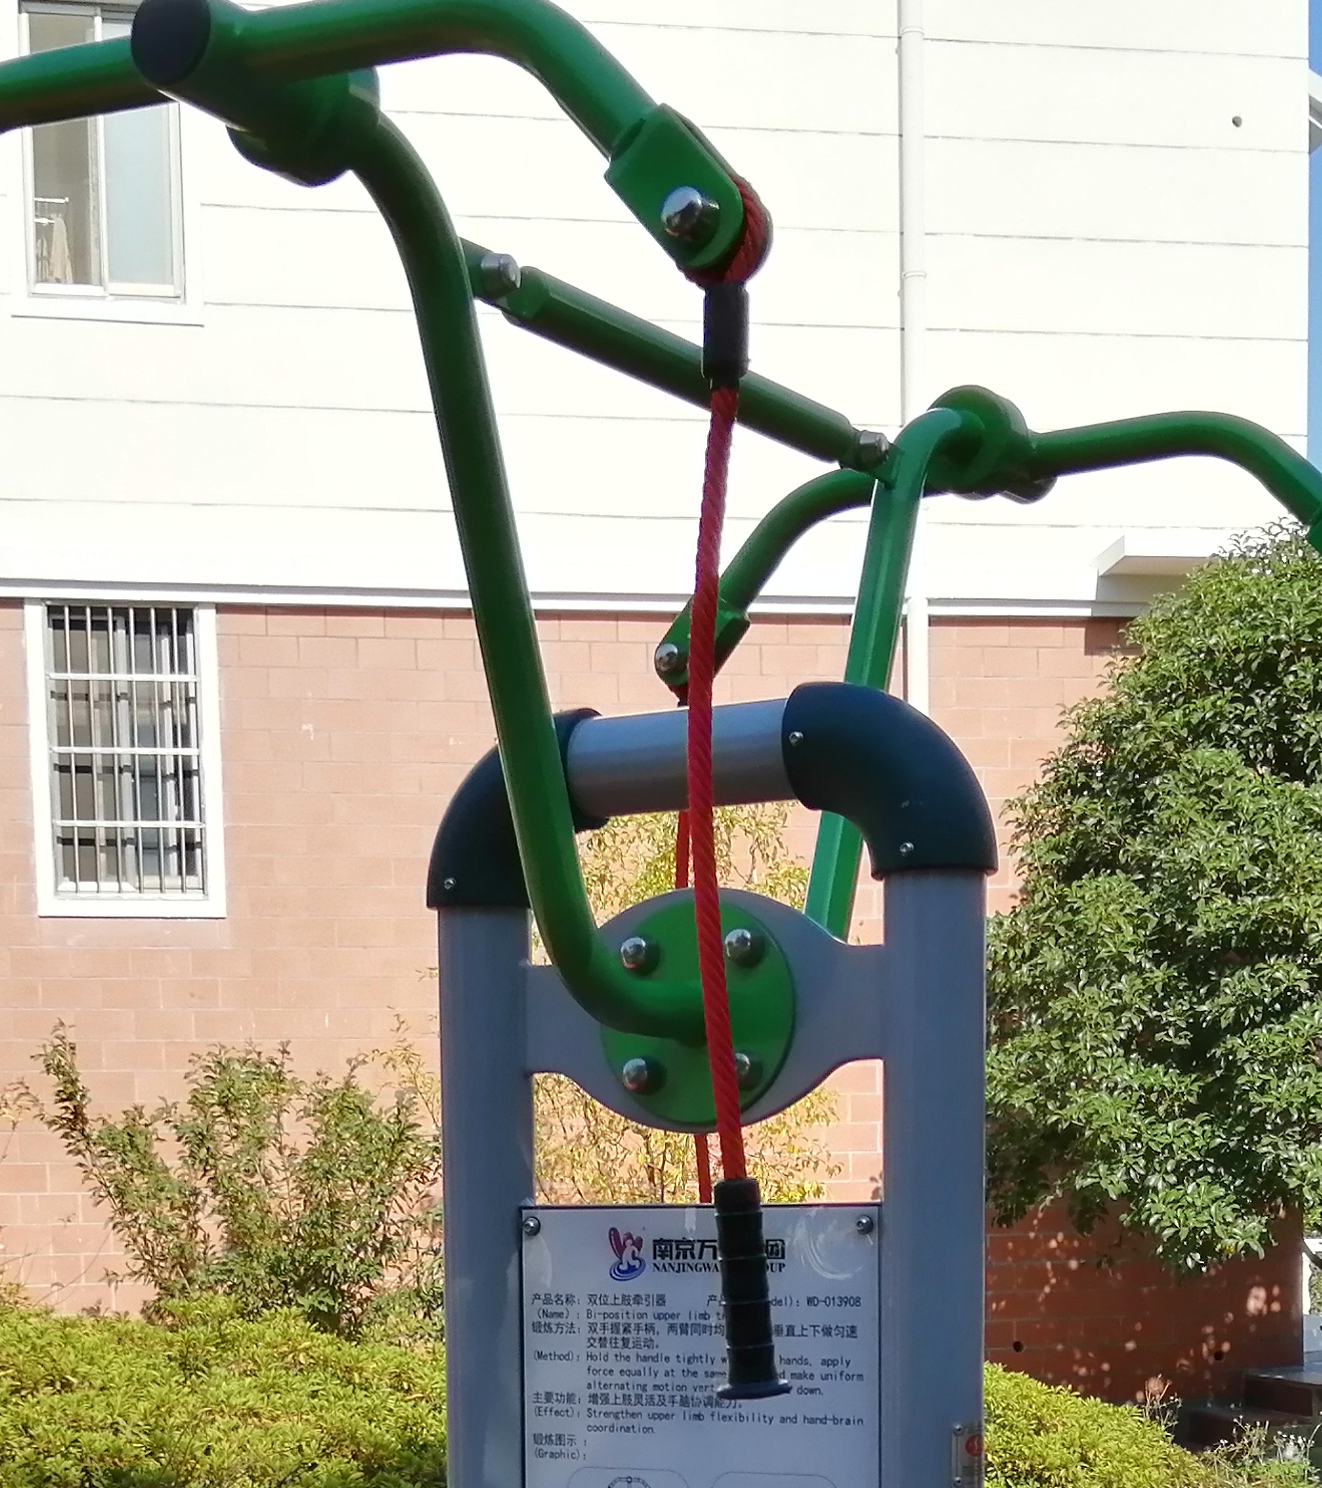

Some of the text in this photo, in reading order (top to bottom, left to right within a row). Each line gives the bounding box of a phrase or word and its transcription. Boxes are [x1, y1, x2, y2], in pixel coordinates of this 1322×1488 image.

[586, 1309, 648, 1321] Bi-position
[653, 1311, 680, 1321] upper
[688, 1310, 710, 1321] limb
[586, 1353, 609, 1362] Hold
[614, 1353, 631, 1362] the
[636, 1353, 670, 1363] handle
[675, 1354, 716, 1365] tightly
[820, 1356, 852, 1368] apply
[586, 1367, 614, 1377] force
[619, 1368, 659, 1379] equally
[664, 1368, 675, 1377] at
[682, 1368, 698, 1378] the
[790, 1370, 815, 1381] make
[820, 1371, 864, 1382] uniform
[586, 1381, 648, 1393] alternating
[652, 1383, 687, 1392] motion
[586, 1408, 643, 1421] Strengthen
[647, 1411, 675, 1422] upper
[682, 1411, 705, 1421] limb
[710, 1412, 774, 1425] flexibility
[779, 1414, 798, 1424] and
[803, 1414, 864, 1426] hand-brain
